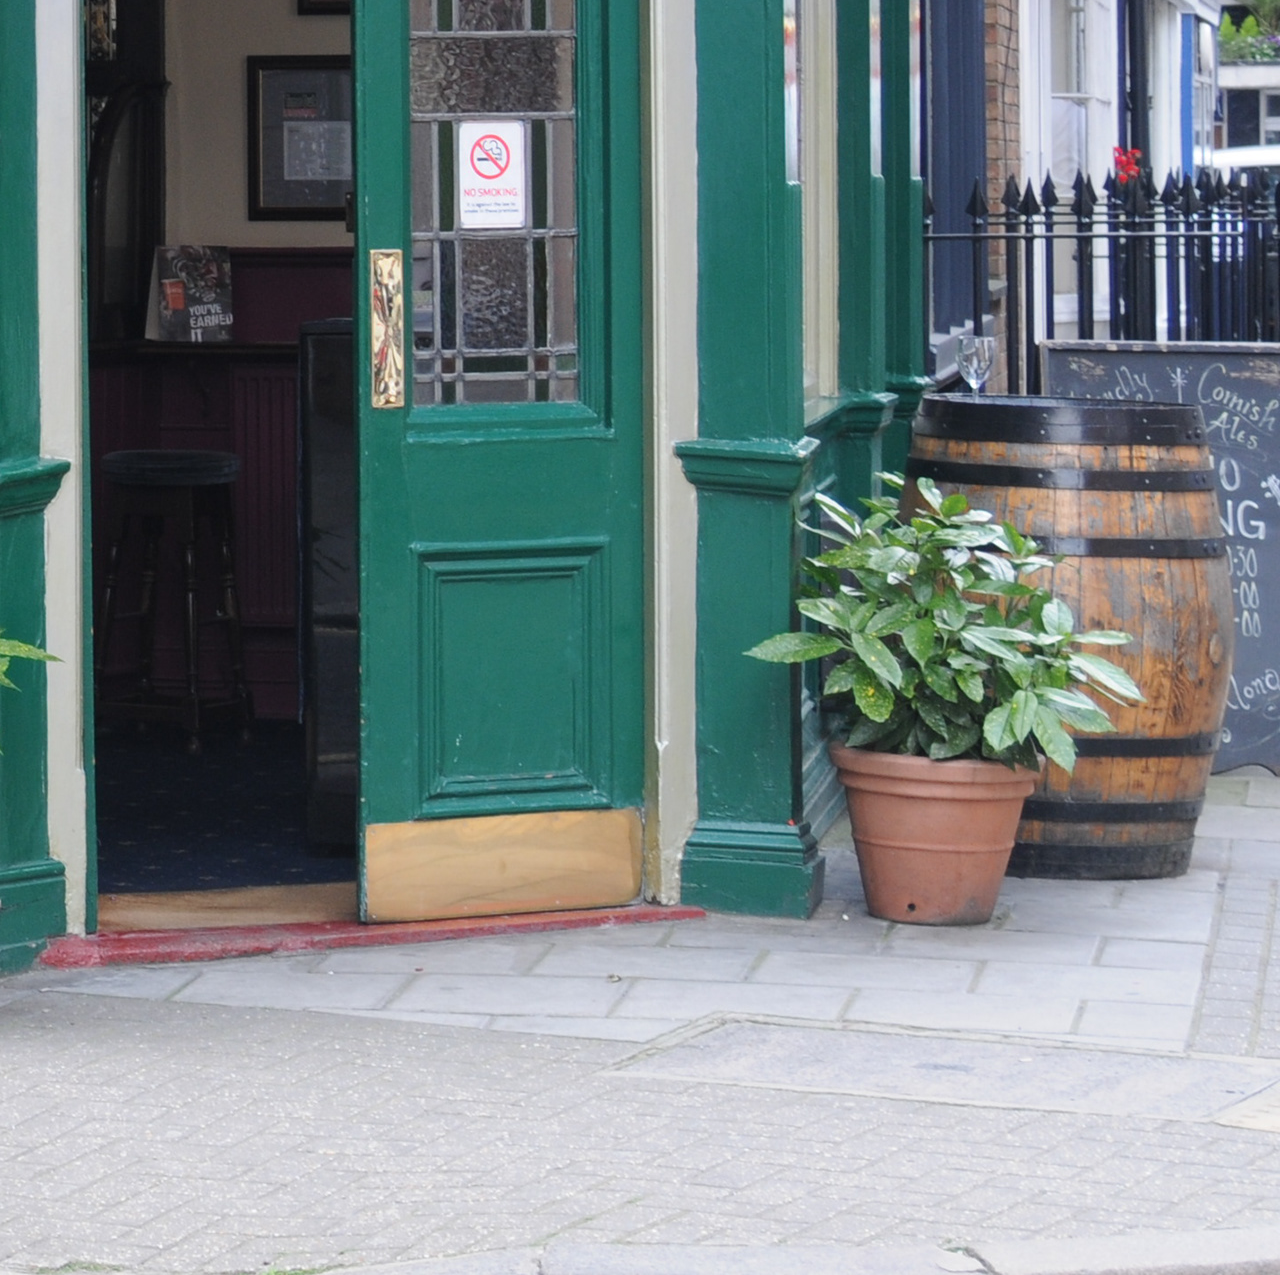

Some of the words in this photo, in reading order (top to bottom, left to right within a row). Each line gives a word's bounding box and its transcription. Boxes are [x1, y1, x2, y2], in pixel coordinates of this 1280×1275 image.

[464, 188, 476, 197] NO
[189, 303, 222, 316] YOU'VE
[190, 313, 233, 328] EARNED
[191, 328, 203, 343] IT
[1198, 363, 1280, 431] Cornish
